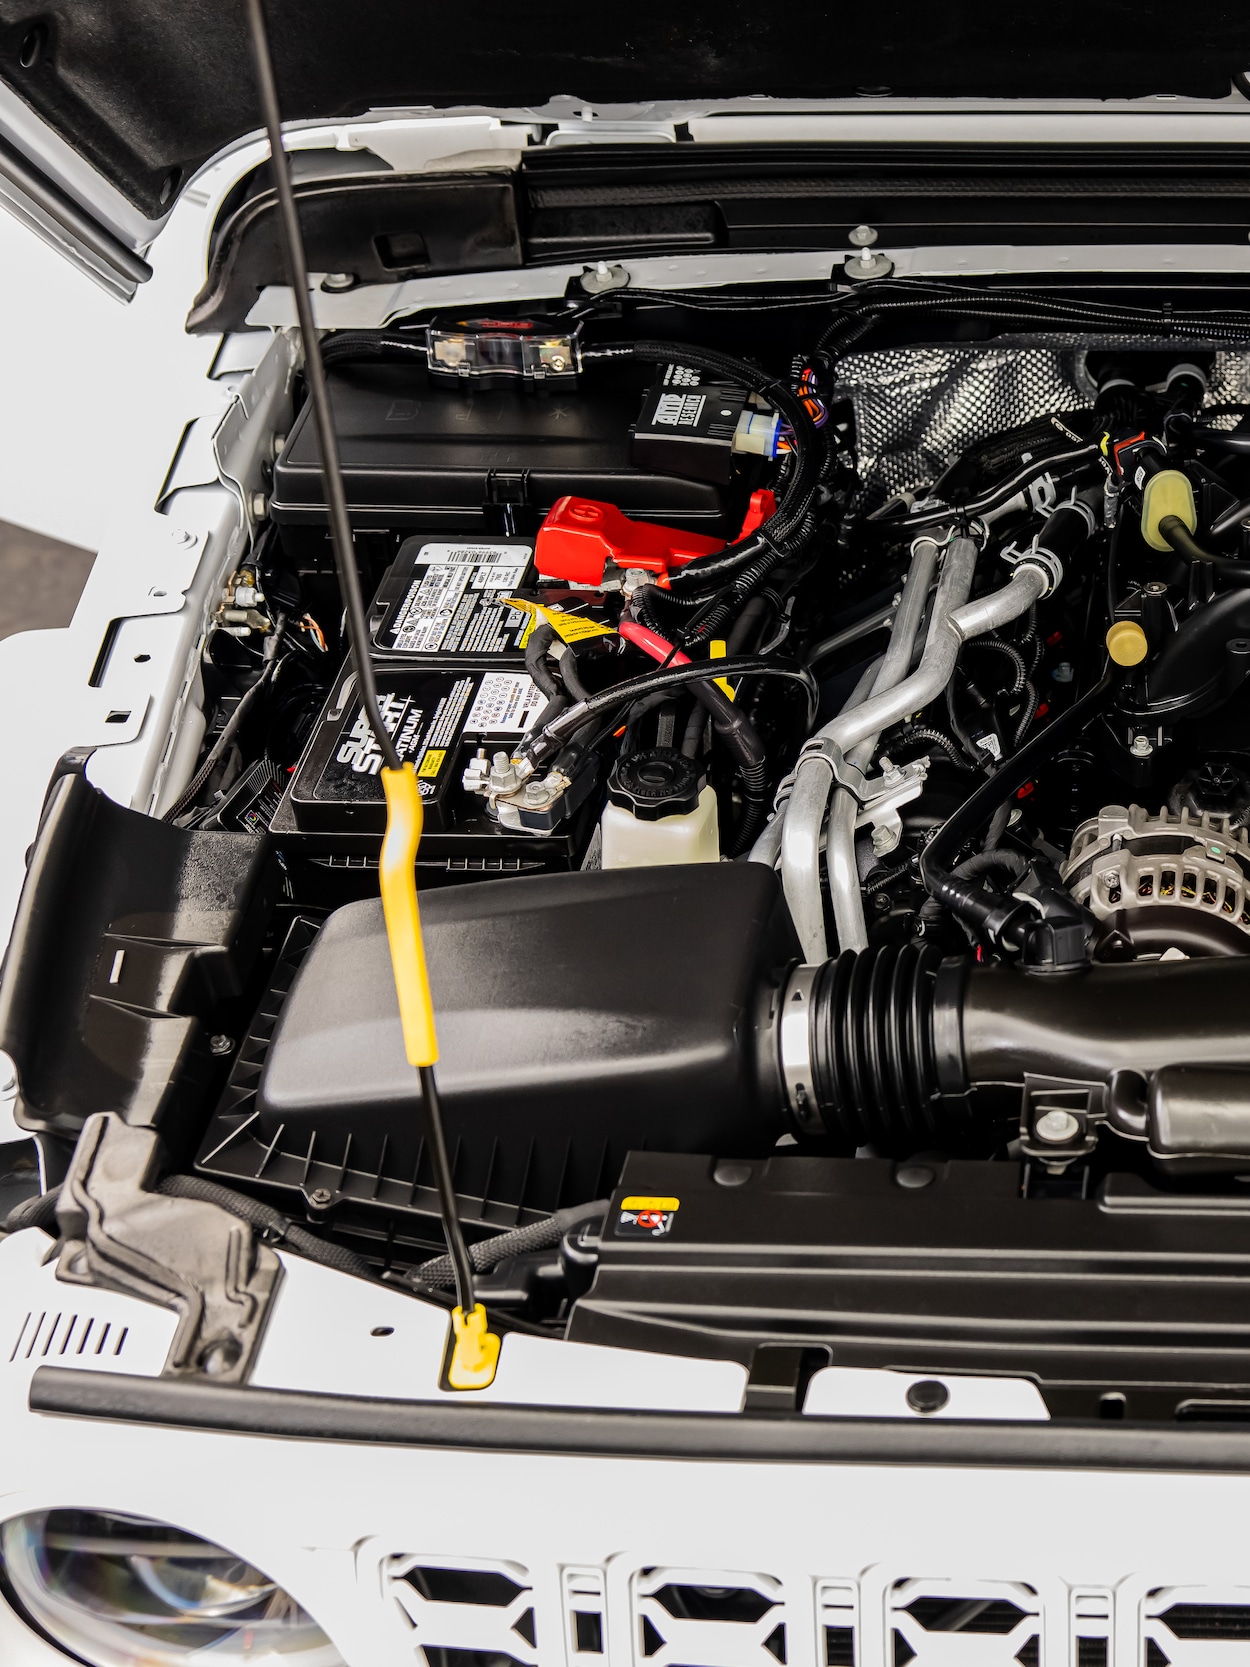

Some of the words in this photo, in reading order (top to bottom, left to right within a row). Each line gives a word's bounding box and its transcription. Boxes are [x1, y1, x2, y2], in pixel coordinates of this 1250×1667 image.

[652, 393, 686, 425] AMP
[678, 395, 701, 426] RESEARCH
[510, 610, 523, 621] Pb
[410, 732, 421, 751] AGM
